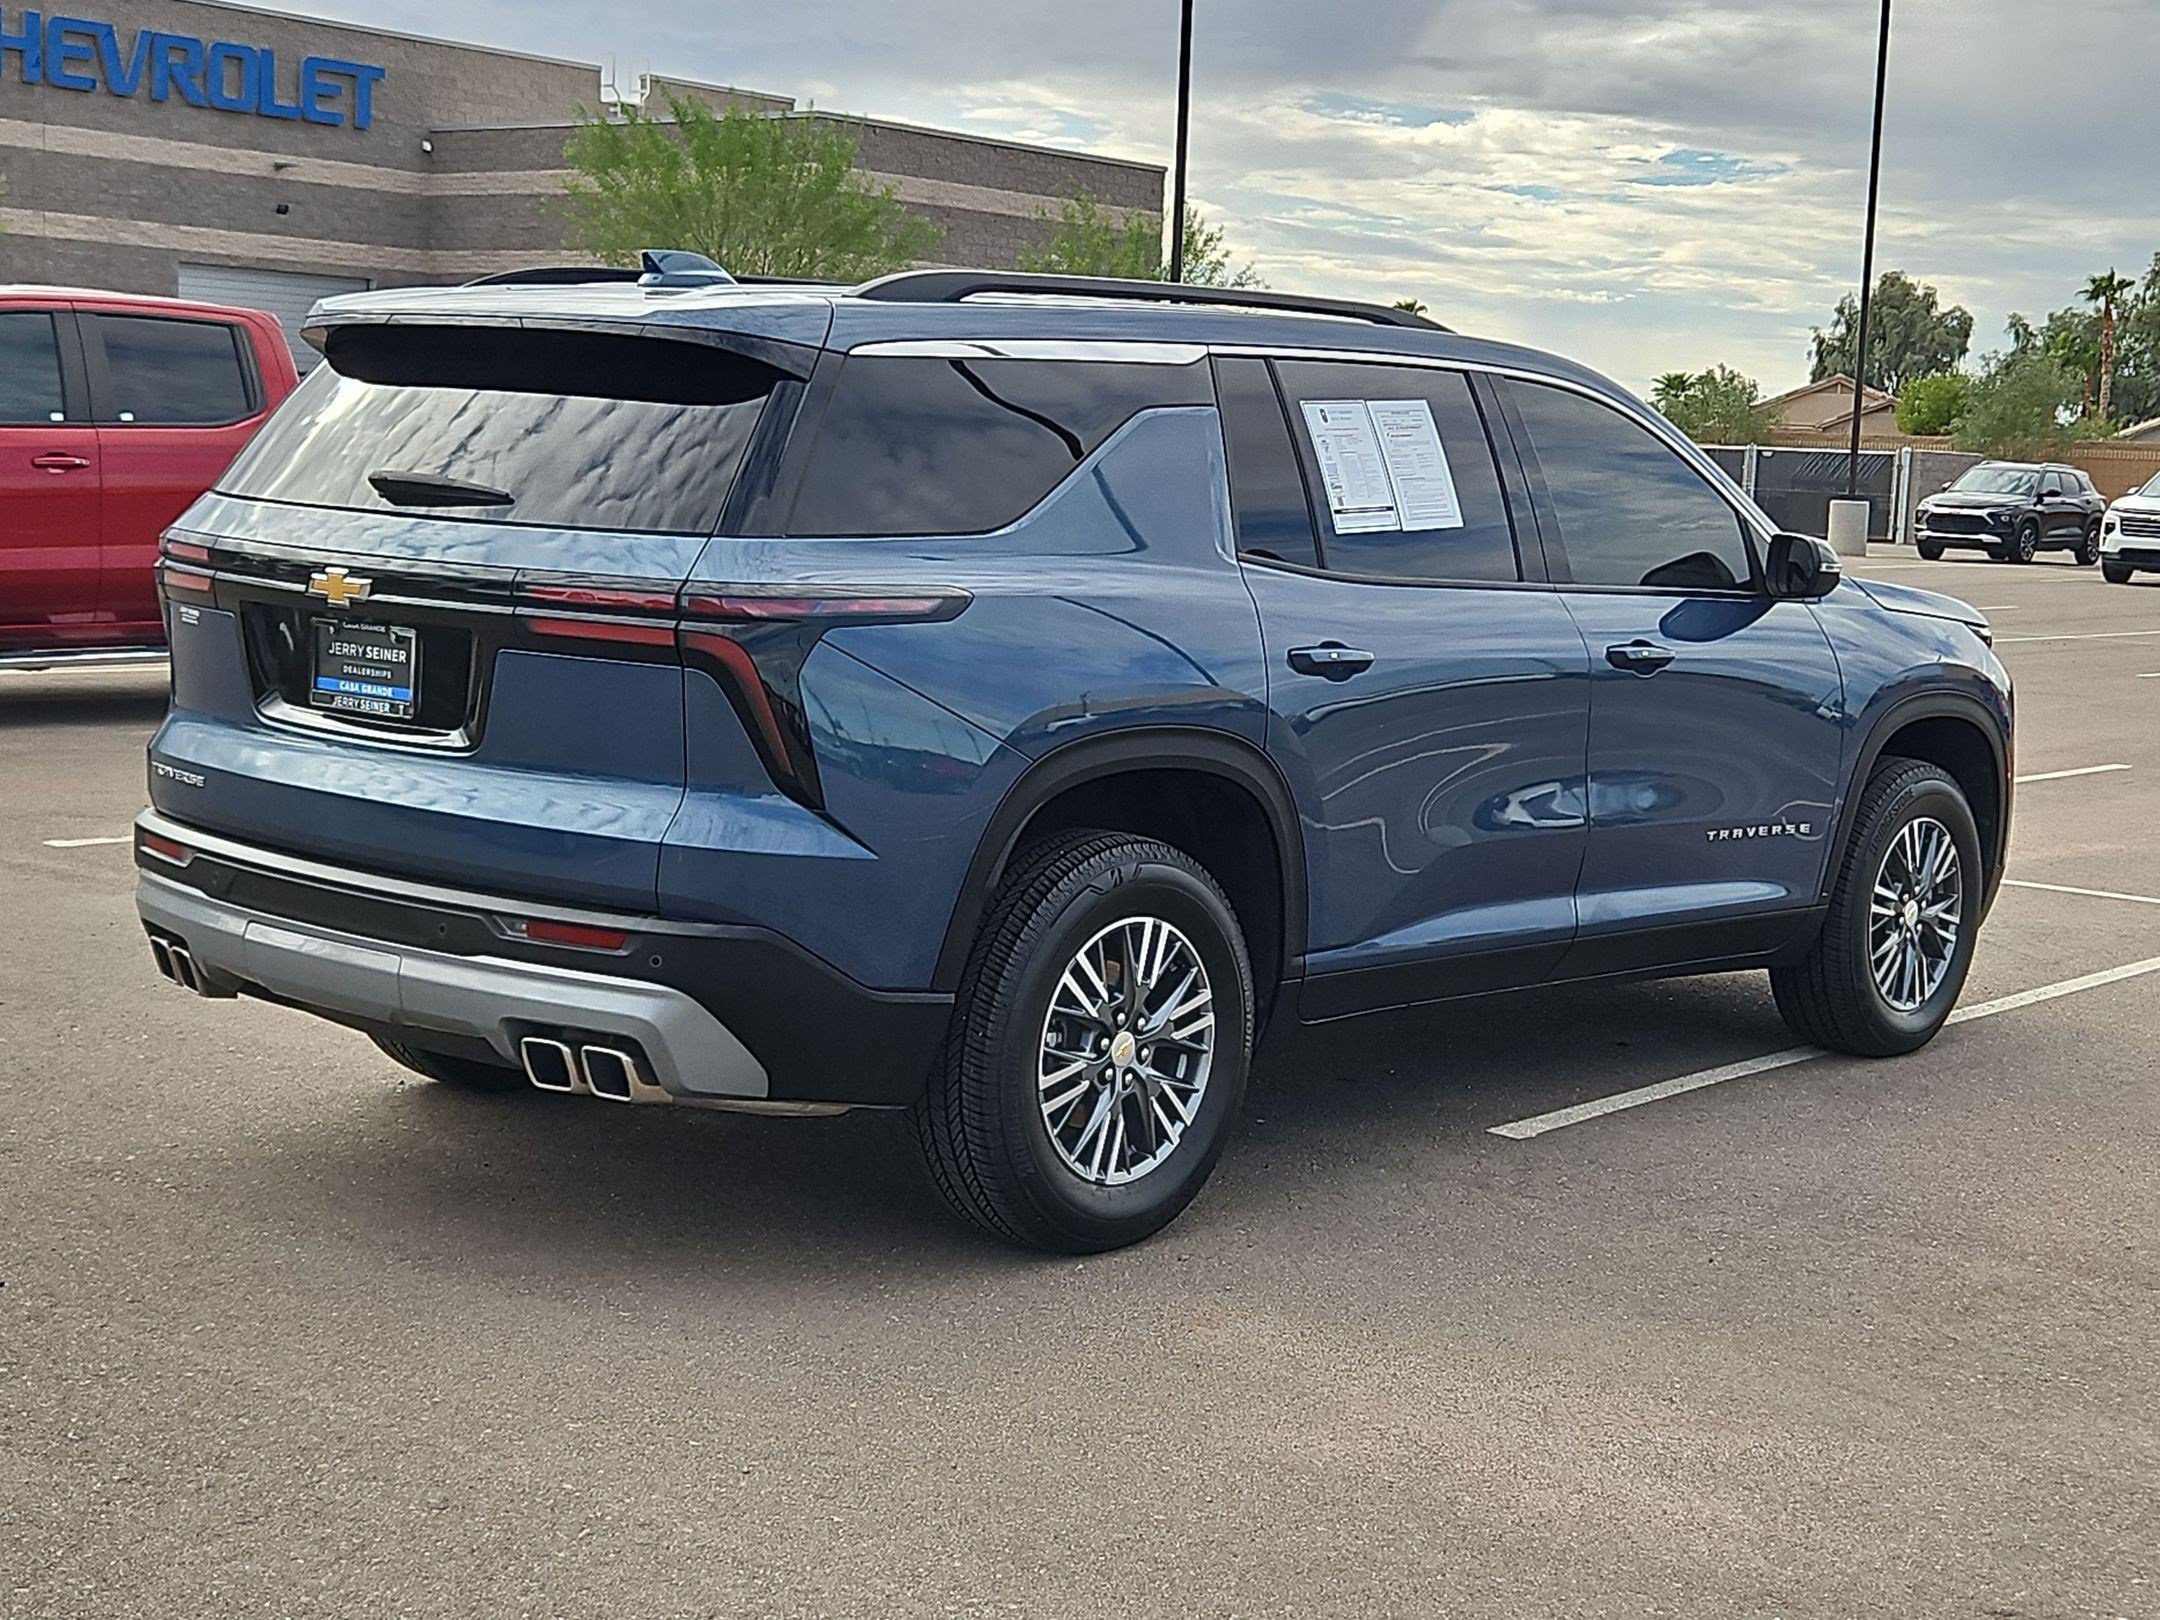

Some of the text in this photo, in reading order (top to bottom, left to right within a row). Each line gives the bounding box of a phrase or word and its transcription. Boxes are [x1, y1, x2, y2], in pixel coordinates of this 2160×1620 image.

[329, 642, 407, 663] JERRY SEINER
[343, 664, 391, 679] DEALERSHIPS
[340, 681, 393, 698] CASA GRANDE
[332, 696, 359, 710] JERRY
[360, 699, 390, 714] SEINER
[1705, 823, 1811, 841] TRAVERSE
